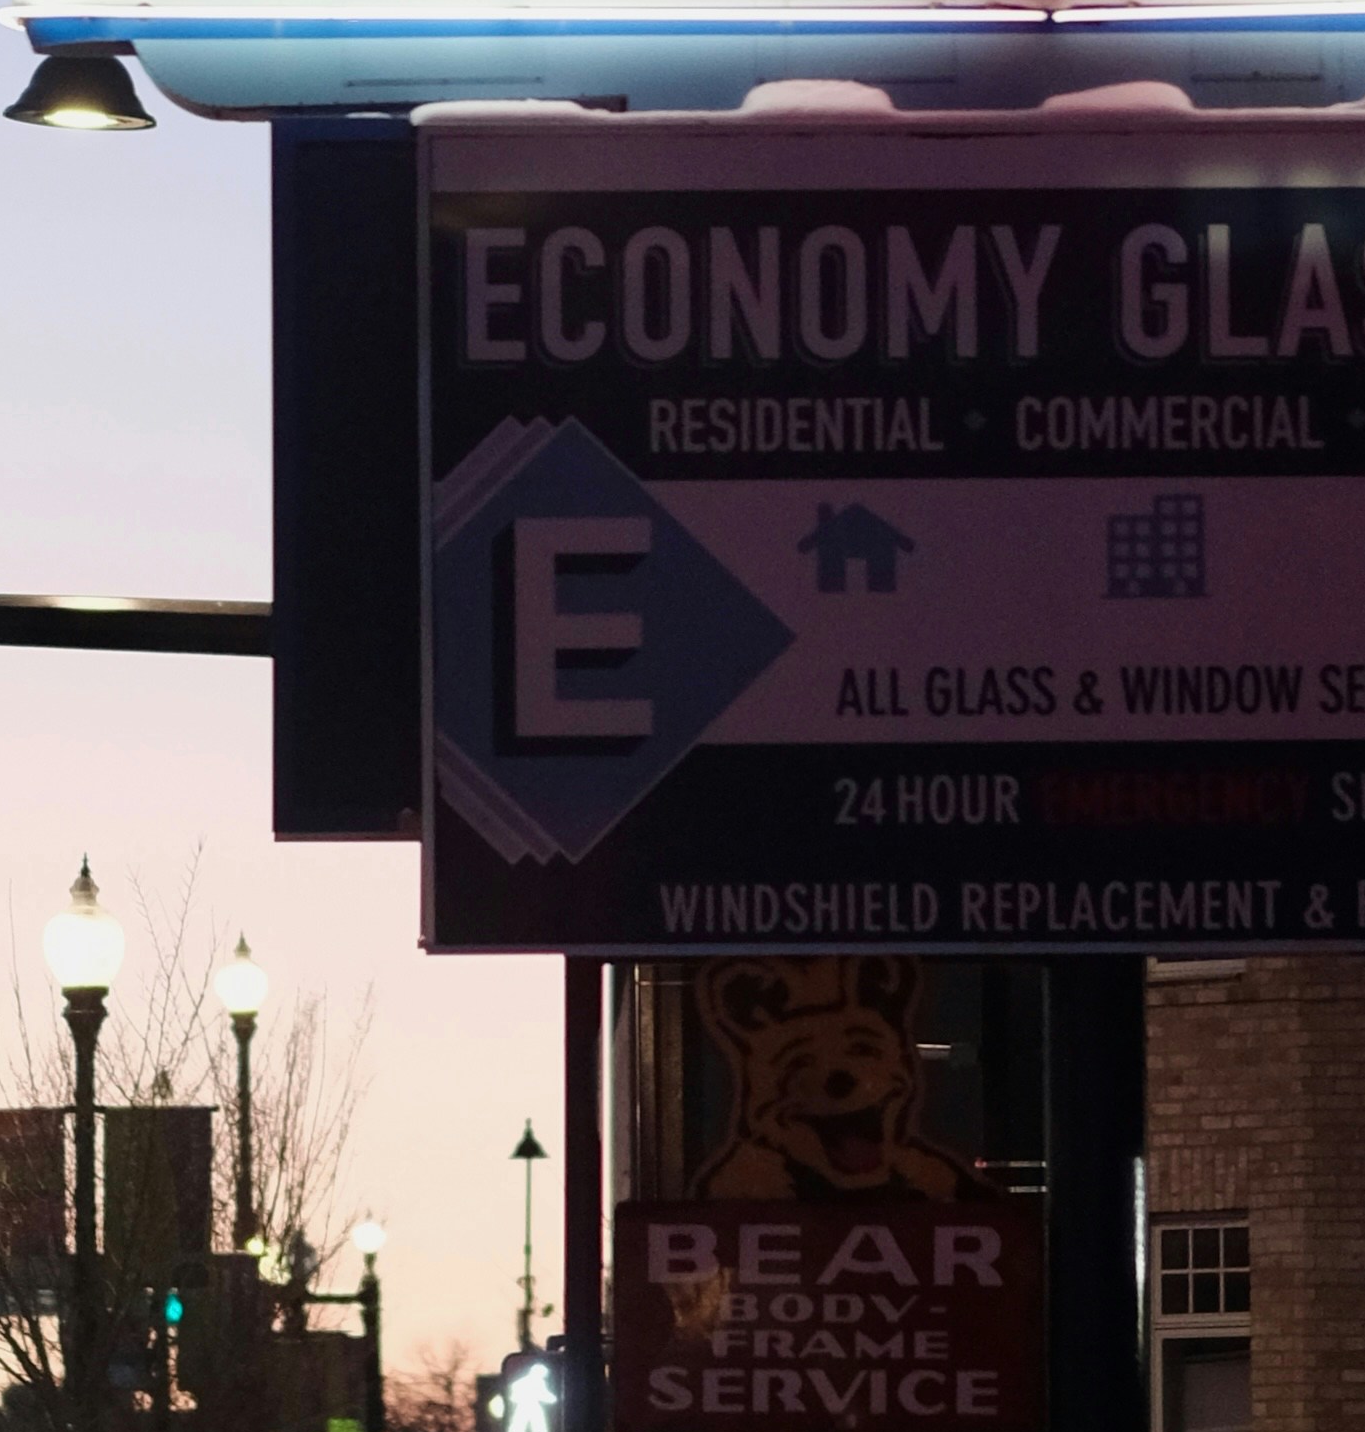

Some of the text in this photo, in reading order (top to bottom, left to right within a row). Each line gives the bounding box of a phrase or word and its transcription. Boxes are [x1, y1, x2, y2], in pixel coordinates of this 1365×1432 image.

[460, 222, 1062, 364] ECONOMY
[648, 397, 945, 455] RESIDENTIAL
[1015, 394, 1324, 451] COMMERCIAL
[513, 516, 654, 738] E
[836, 666, 909, 718] ALL
[925, 666, 1056, 717] GLASS
[1074, 666, 1105, 716] &
[1120, 664, 1302, 716] WINDOW
[835, 777, 887, 827] 24
[897, 775, 1021, 826] HOUR
[1044, 772, 1312, 826] EMERGENCY
[660, 883, 940, 935] WINDSHIELD
[960, 880, 1284, 932] REPLACEMENT
[1304, 882, 1336, 930] &
[647, 1224, 1005, 1287] BEAR
[710, 1329, 950, 1361] FRAME
[647, 1367, 1000, 1415] SERVICE
